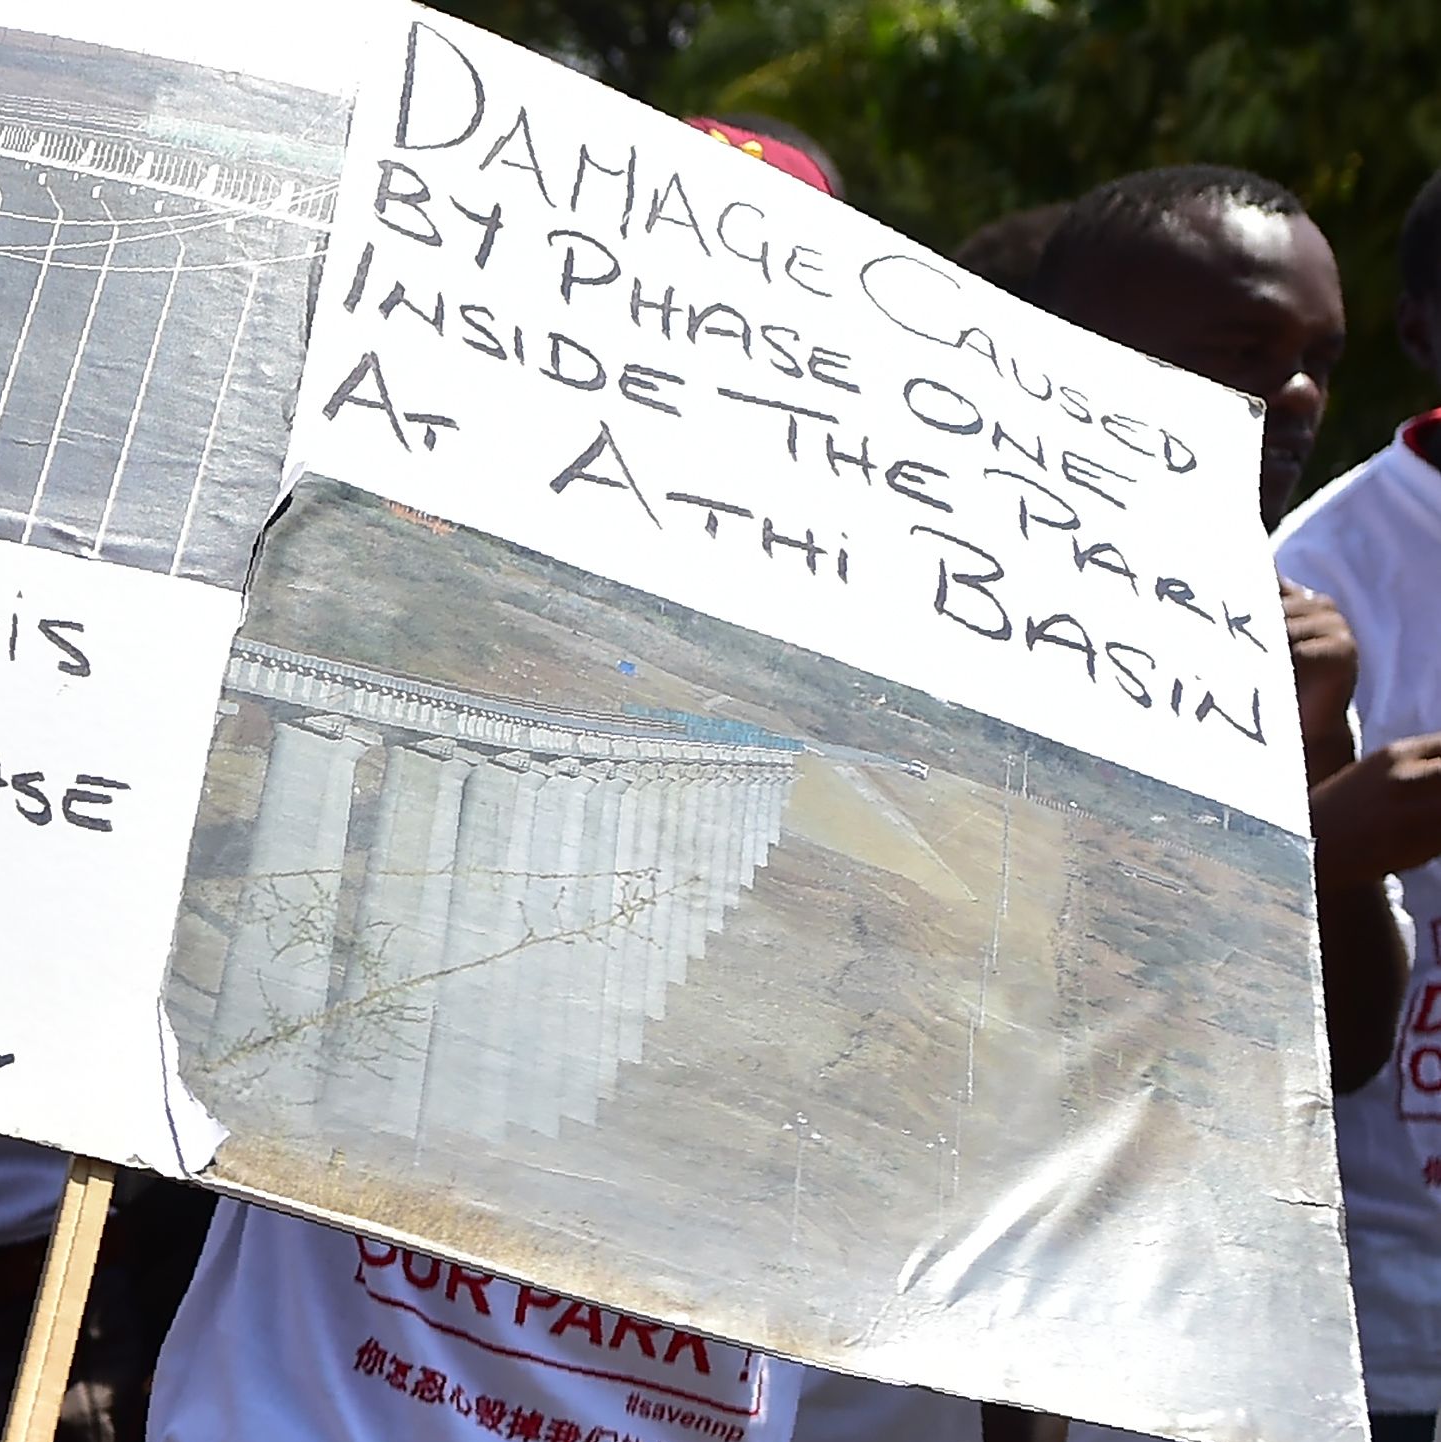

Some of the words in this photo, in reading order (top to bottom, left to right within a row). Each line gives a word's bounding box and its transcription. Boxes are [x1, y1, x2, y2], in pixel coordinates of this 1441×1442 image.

[321, 350, 460, 452] AT
[373, 159, 504, 270] BY
[547, 229, 861, 394] PHASE
[902, 377, 1137, 510] ONE
[394, 22, 833, 298] DAMAGE
[860, 255, 1198, 474] CAUSED
[342, 241, 686, 417] INSIDE
[717, 387, 954, 514] THE
[983, 467, 1269, 653] PARK
